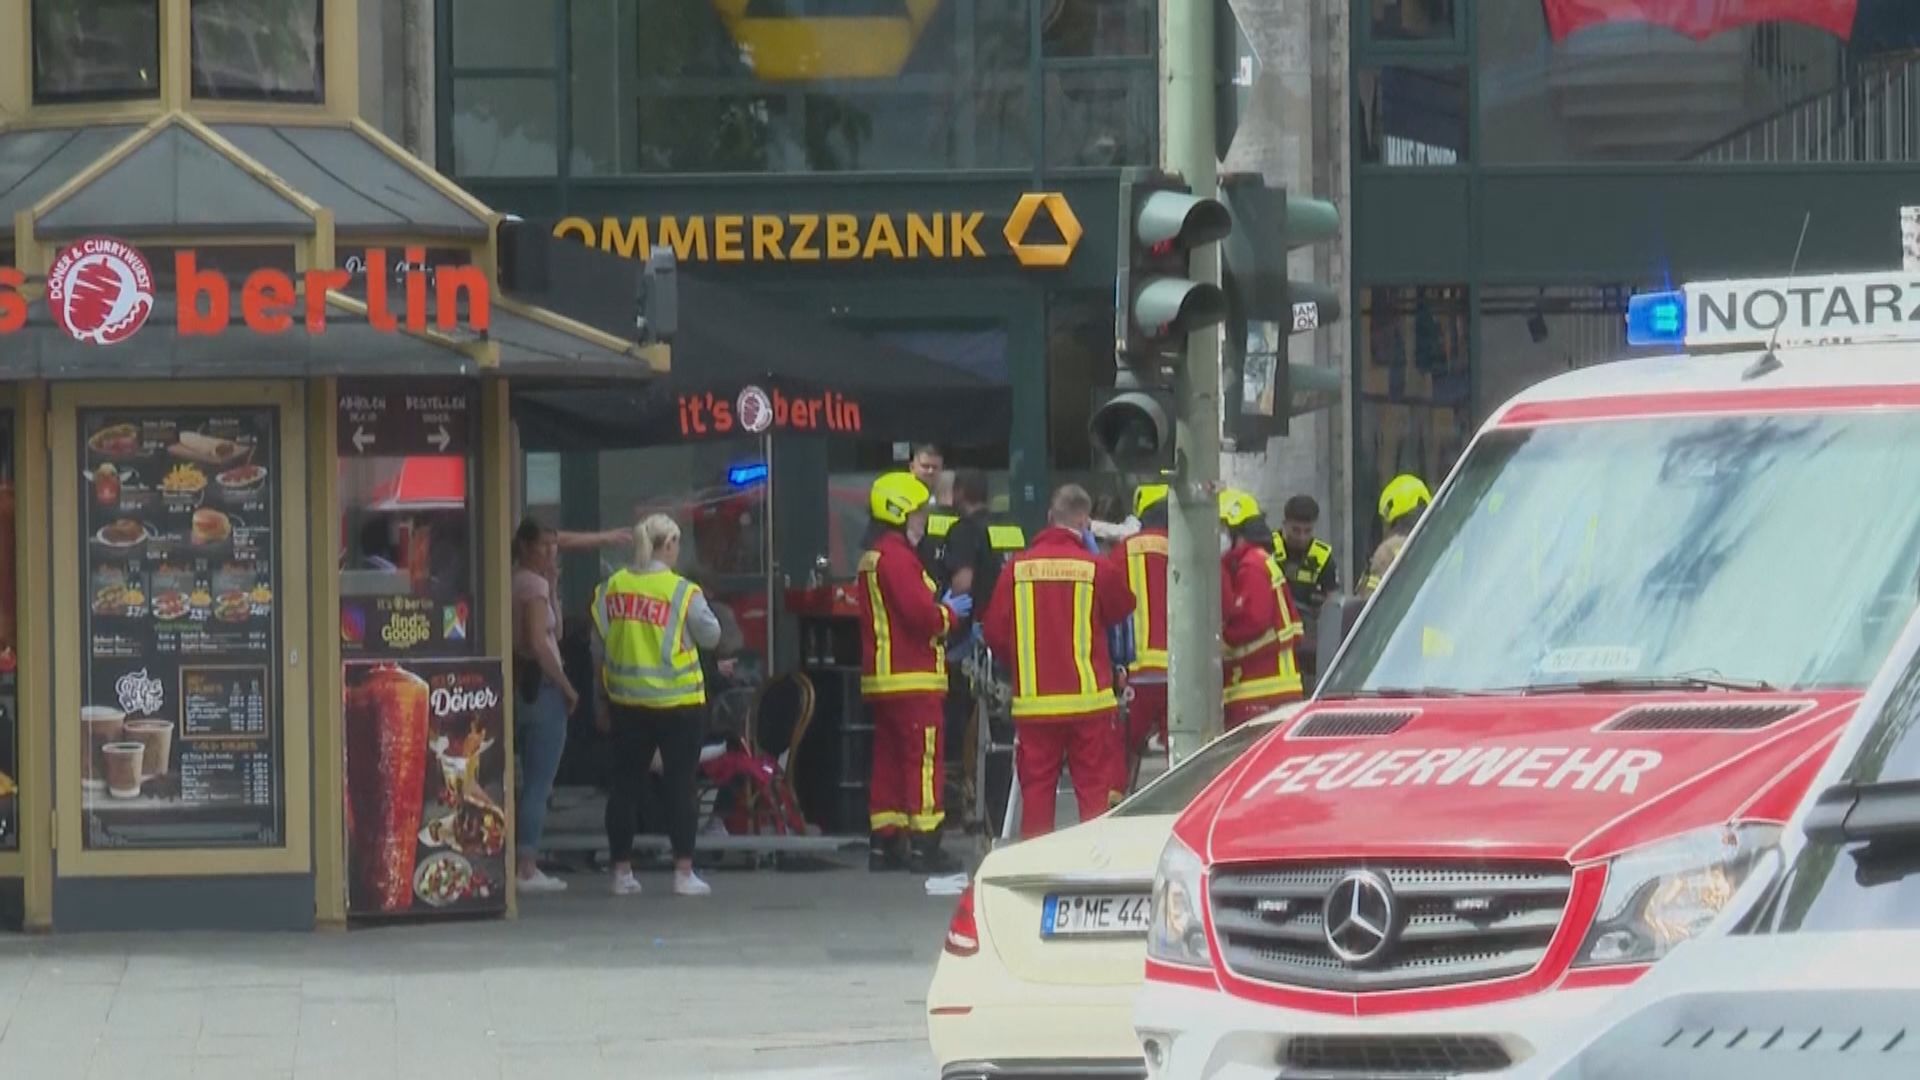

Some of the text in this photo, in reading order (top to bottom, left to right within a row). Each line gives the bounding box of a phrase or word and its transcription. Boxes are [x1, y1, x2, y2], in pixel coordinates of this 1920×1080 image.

[552, 211, 986, 263] OMMERZBANK
[71, 247, 83, 258] &
[84, 239, 151, 290] CURRYWURST
[175, 245, 489, 336] berlin
[1297, 316, 1316, 328] OK
[678, 387, 862, 436] it's berlin
[381, 625, 430, 645] Google
[431, 686, 499, 717] Döner
[1243, 746, 1663, 801] FEUERWEHR
[1056, 899, 1070, 929] B
[1083, 898, 1113, 929] ME
